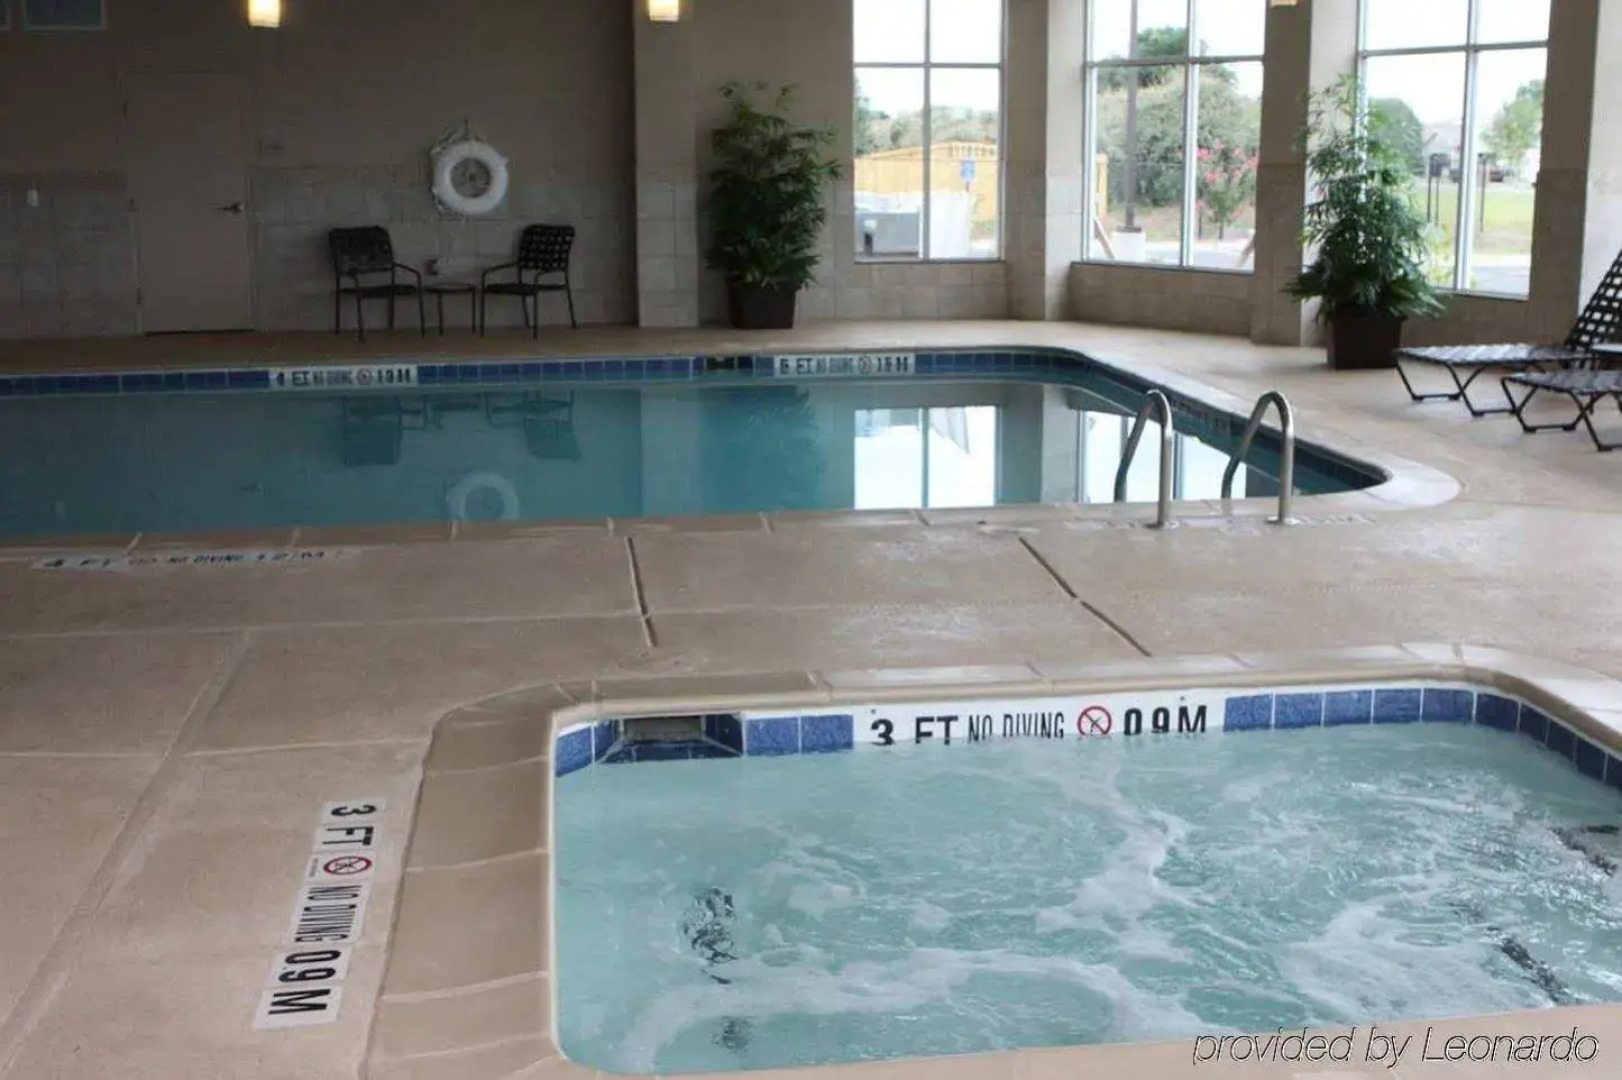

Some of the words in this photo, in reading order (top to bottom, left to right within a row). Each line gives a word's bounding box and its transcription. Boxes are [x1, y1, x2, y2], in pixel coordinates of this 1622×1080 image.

[870, 718, 895, 746] 3
[915, 715, 958, 745] FT
[968, 714, 991, 741] NO
[1002, 711, 1065, 739] DIVING
[330, 804, 376, 817] 3
[322, 826, 374, 846] FT
[307, 885, 362, 901] NO
[294, 903, 357, 943] DIVING
